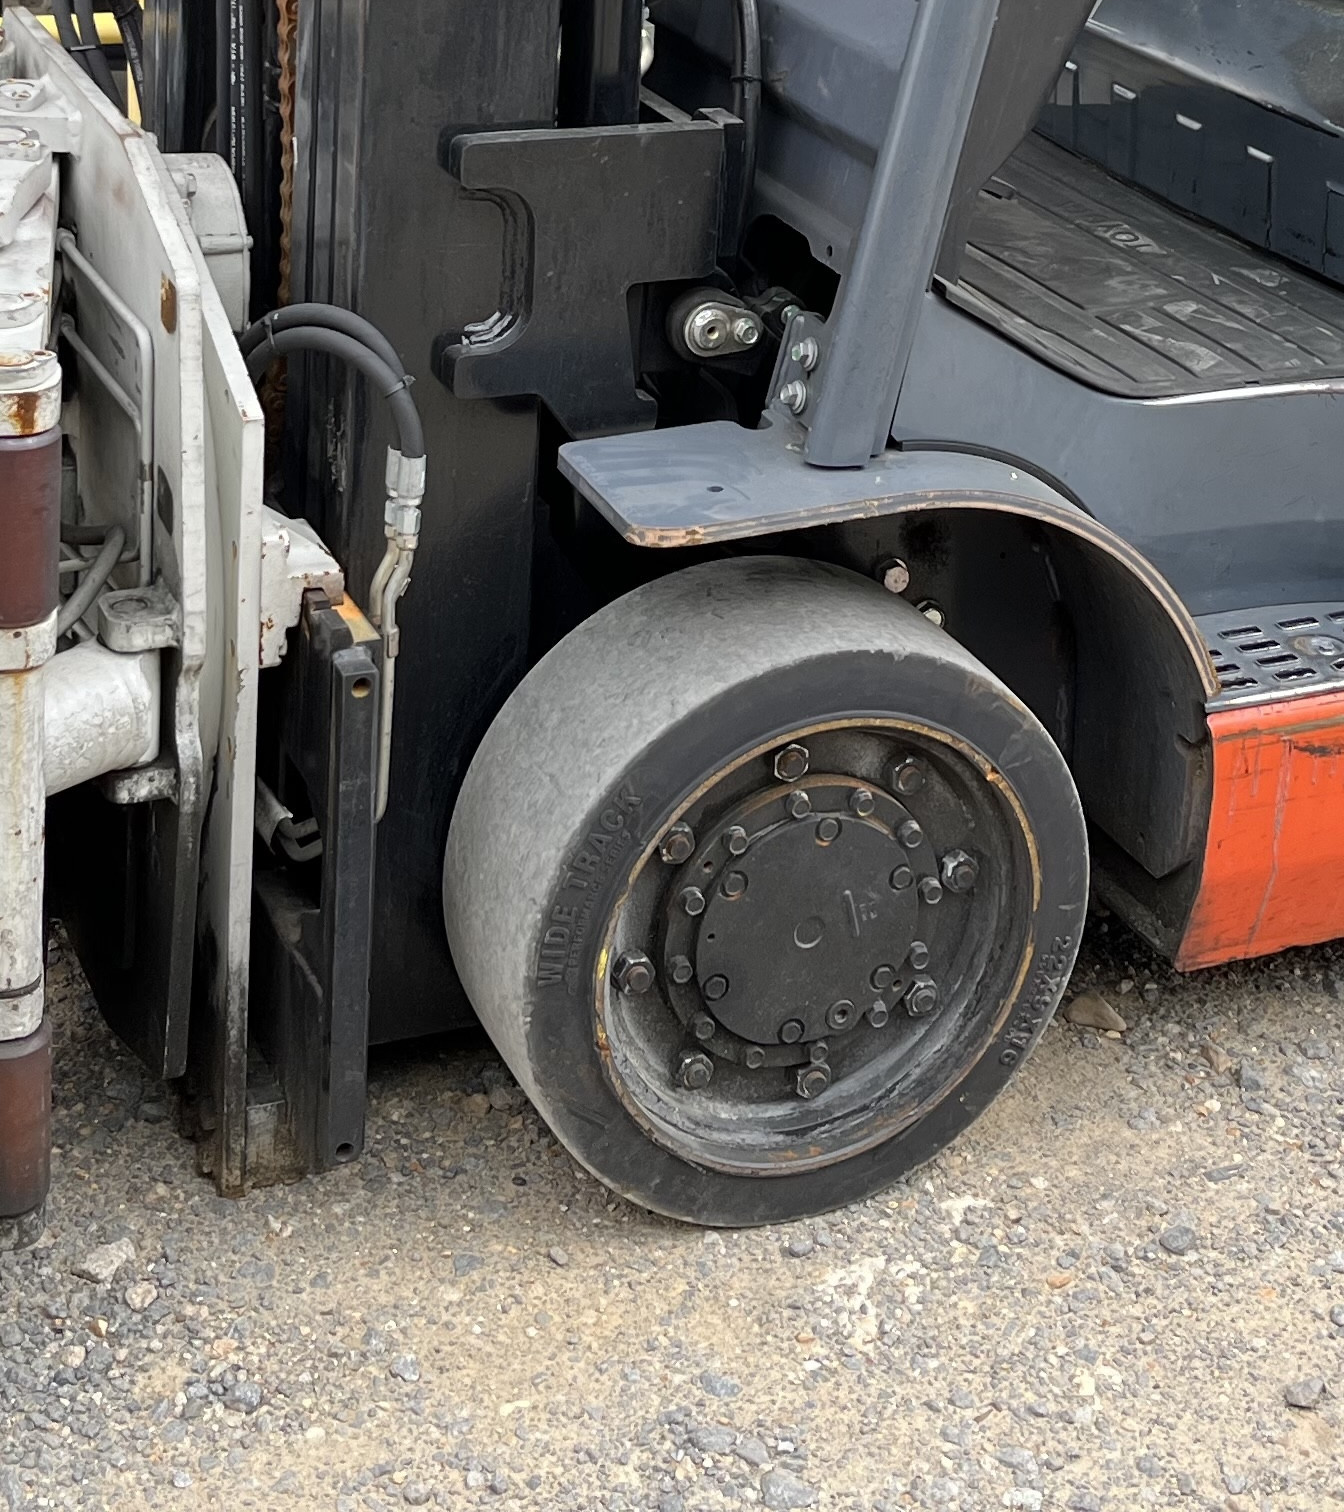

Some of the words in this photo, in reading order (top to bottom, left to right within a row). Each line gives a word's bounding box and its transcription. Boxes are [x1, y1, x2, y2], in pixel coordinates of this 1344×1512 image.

[537, 904, 578, 987] WIDE
[562, 789, 642, 889] TRACK
[603, 828, 632, 873] SERIES
